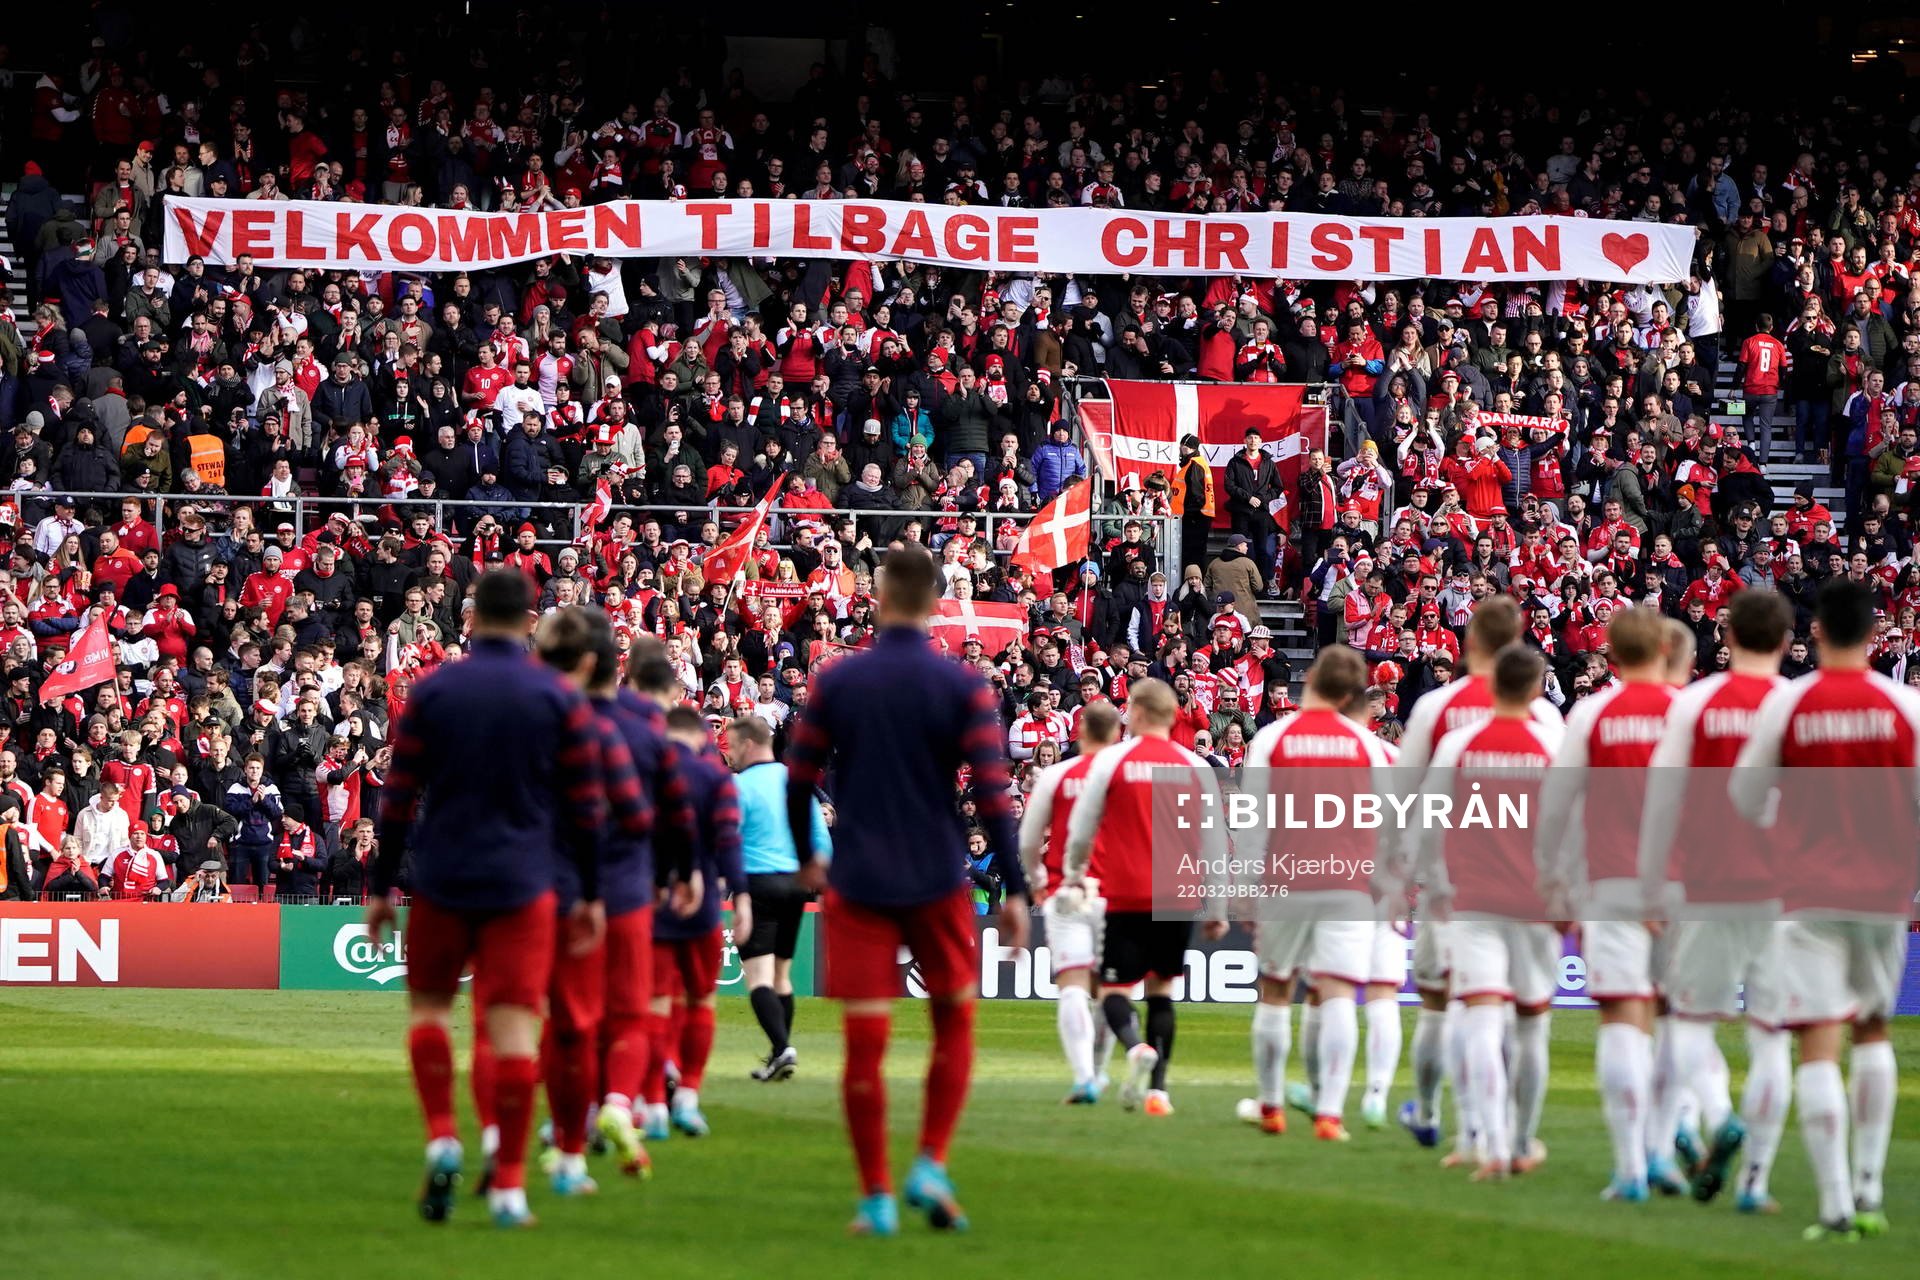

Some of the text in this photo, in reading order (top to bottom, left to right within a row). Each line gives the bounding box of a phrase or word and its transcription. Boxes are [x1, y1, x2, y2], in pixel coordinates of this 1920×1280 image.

[174, 204, 1560, 275] VELKOMMEN TILBAGE CHRISTIAN
[1761, 348, 1770, 372] 8
[481, 378, 490, 389] 10
[1480, 412, 1561, 431] DANMARK
[764, 586, 804, 595] DANMARK
[1794, 709, 1897, 744] DANMARK
[1282, 734, 1358, 759] DANMARK
[1, 918, 119, 981] EN
